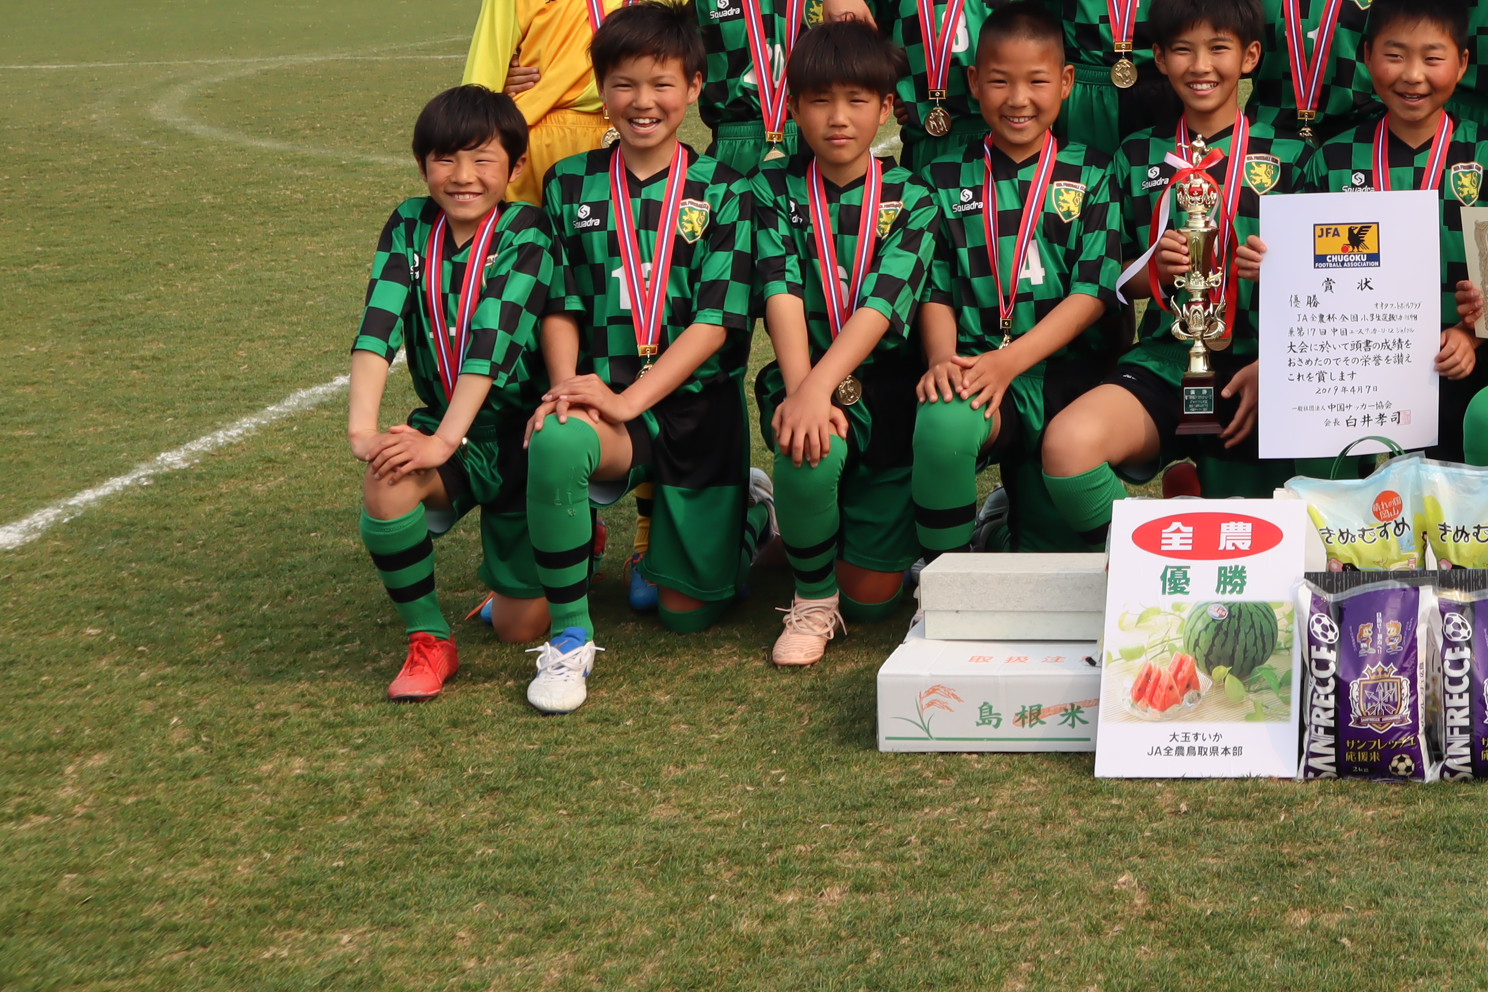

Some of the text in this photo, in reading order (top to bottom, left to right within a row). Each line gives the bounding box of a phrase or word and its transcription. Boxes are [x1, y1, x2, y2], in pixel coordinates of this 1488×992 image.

[709, 6, 741, 20] Squadra
[1142, 177, 1169, 190] Squadra
[953, 201, 984, 213] Squadra
[573, 217, 600, 229] Squadra
[1317, 227, 1340, 238] JFA
[1019, 239, 1046, 285] 4
[1326, 254, 1367, 263] CHUGOKU
[1289, 294, 1321, 309] 優勝
[1287, 370, 1357, 383] これを賞します
[1160, 521, 1253, 551] 全農
[1319, 516, 1411, 545] きぬむすめ
[1160, 565, 1247, 596] 優勝
[968, 655, 1087, 664] 取扱注
[975, 701, 1090, 730] 島根米
[1443, 646, 1475, 781] SANFRECCE
[1169, 731, 1223, 743] 大玉すいか
[1346, 735, 1416, 750] サンフレッチェ
[1147, 745, 1244, 758] JA全農鳥取県本部
[1345, 751, 1380, 763] 応援米
